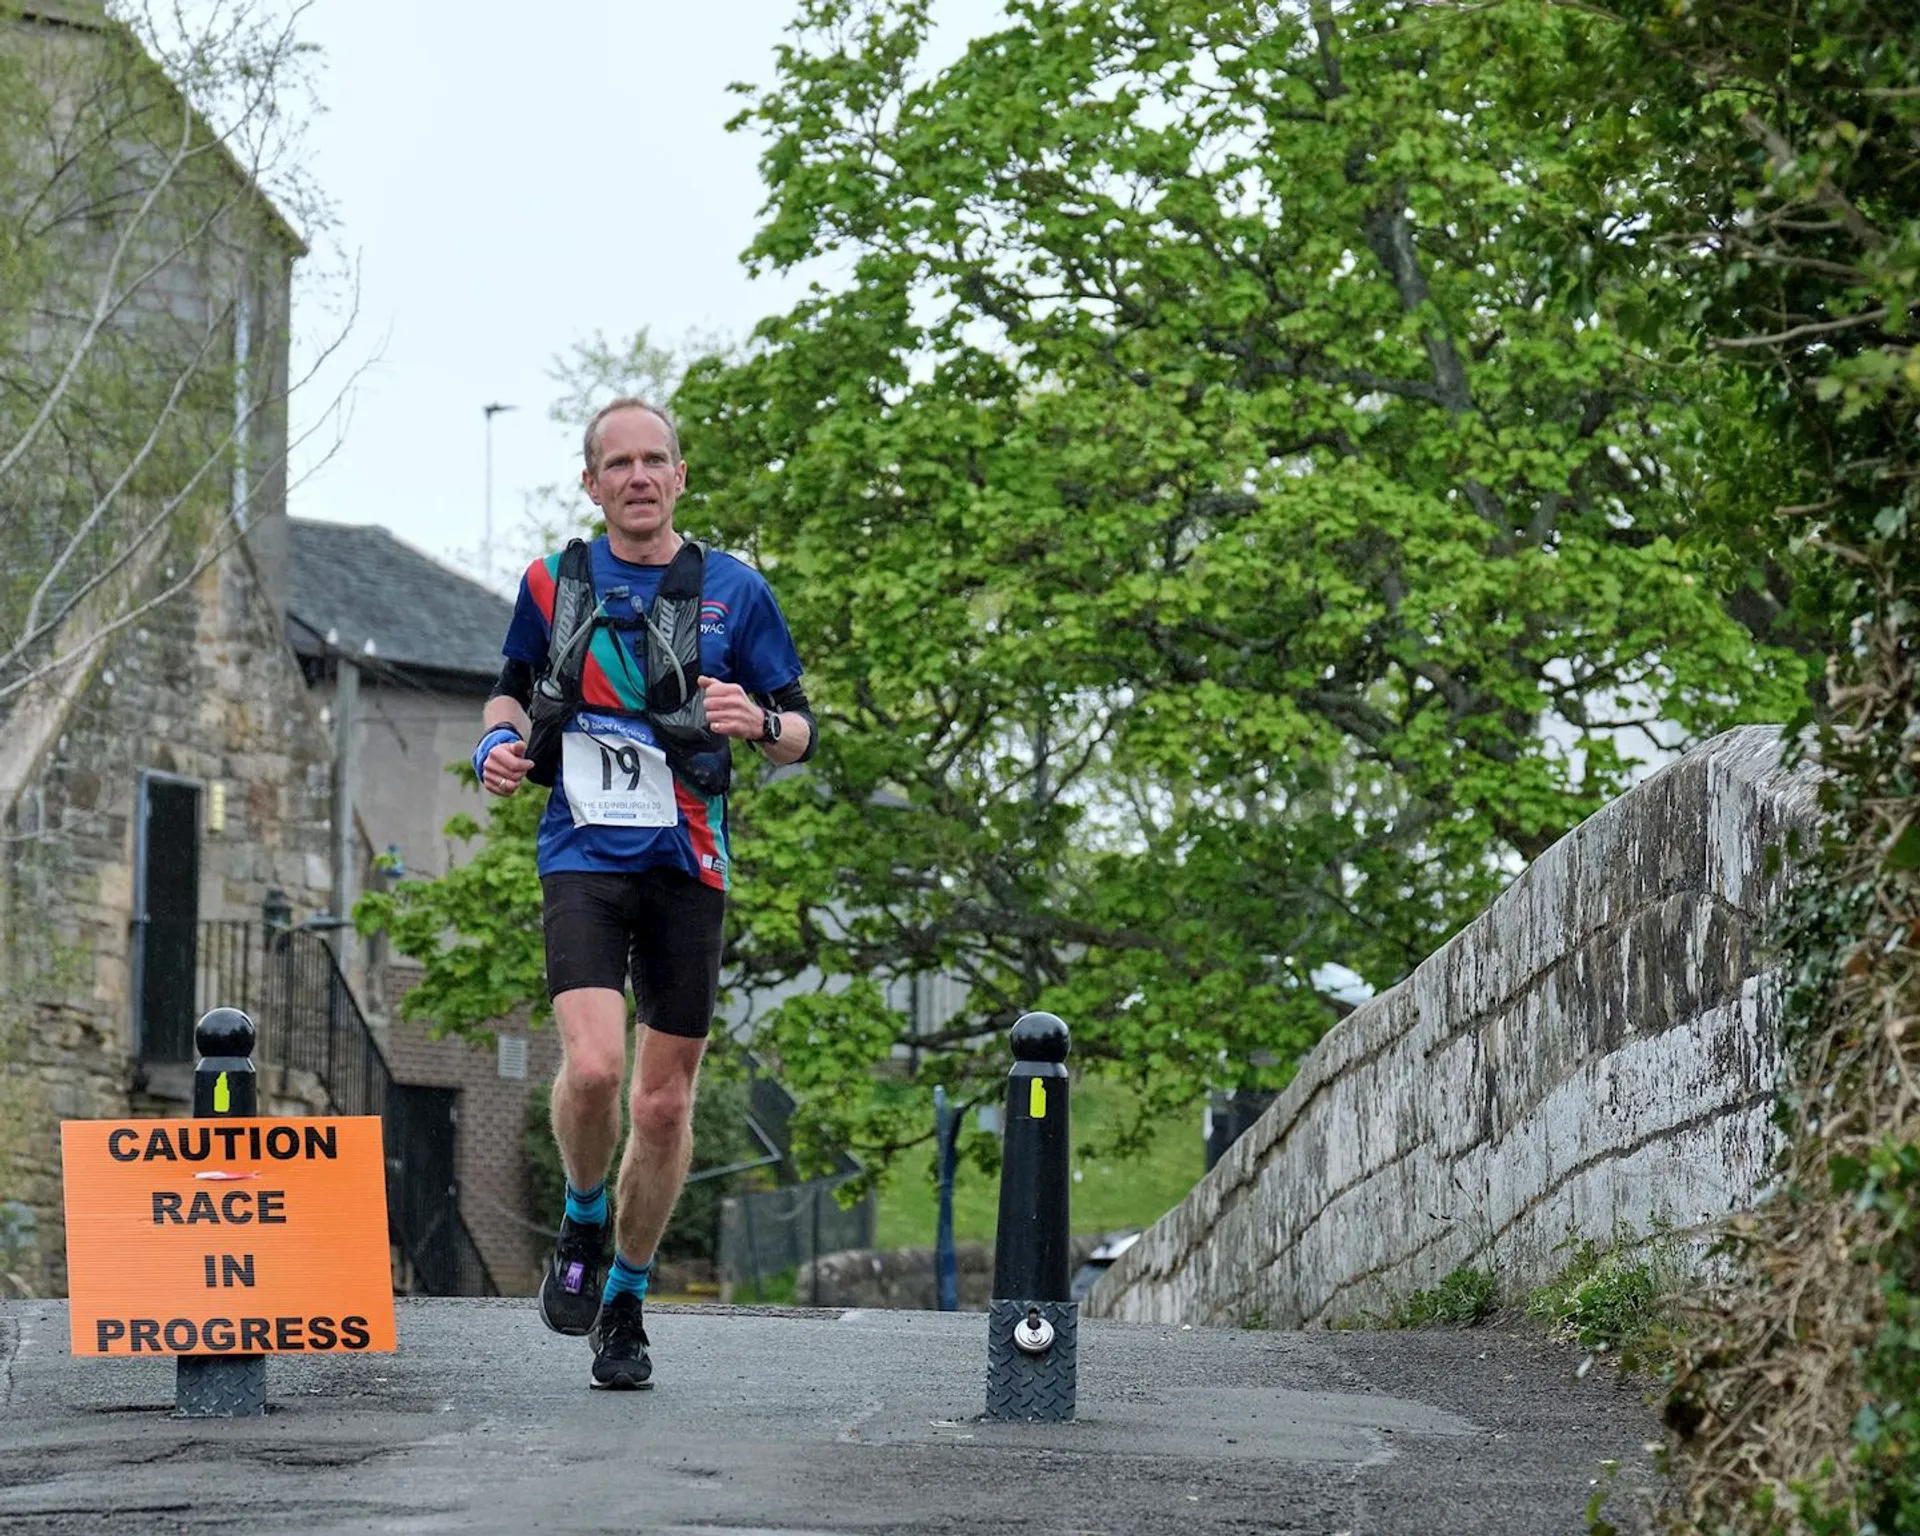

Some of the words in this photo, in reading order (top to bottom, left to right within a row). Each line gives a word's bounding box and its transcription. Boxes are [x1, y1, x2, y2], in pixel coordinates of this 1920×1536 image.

[600, 746, 641, 790] 19
[579, 801, 597, 809] THE
[599, 801, 650, 809] EDINBURGH
[109, 1127, 337, 1161] CAUTION
[152, 1191, 286, 1224] RACE
[205, 1255, 255, 1287] IN
[97, 1316, 370, 1351] PROGRESS
